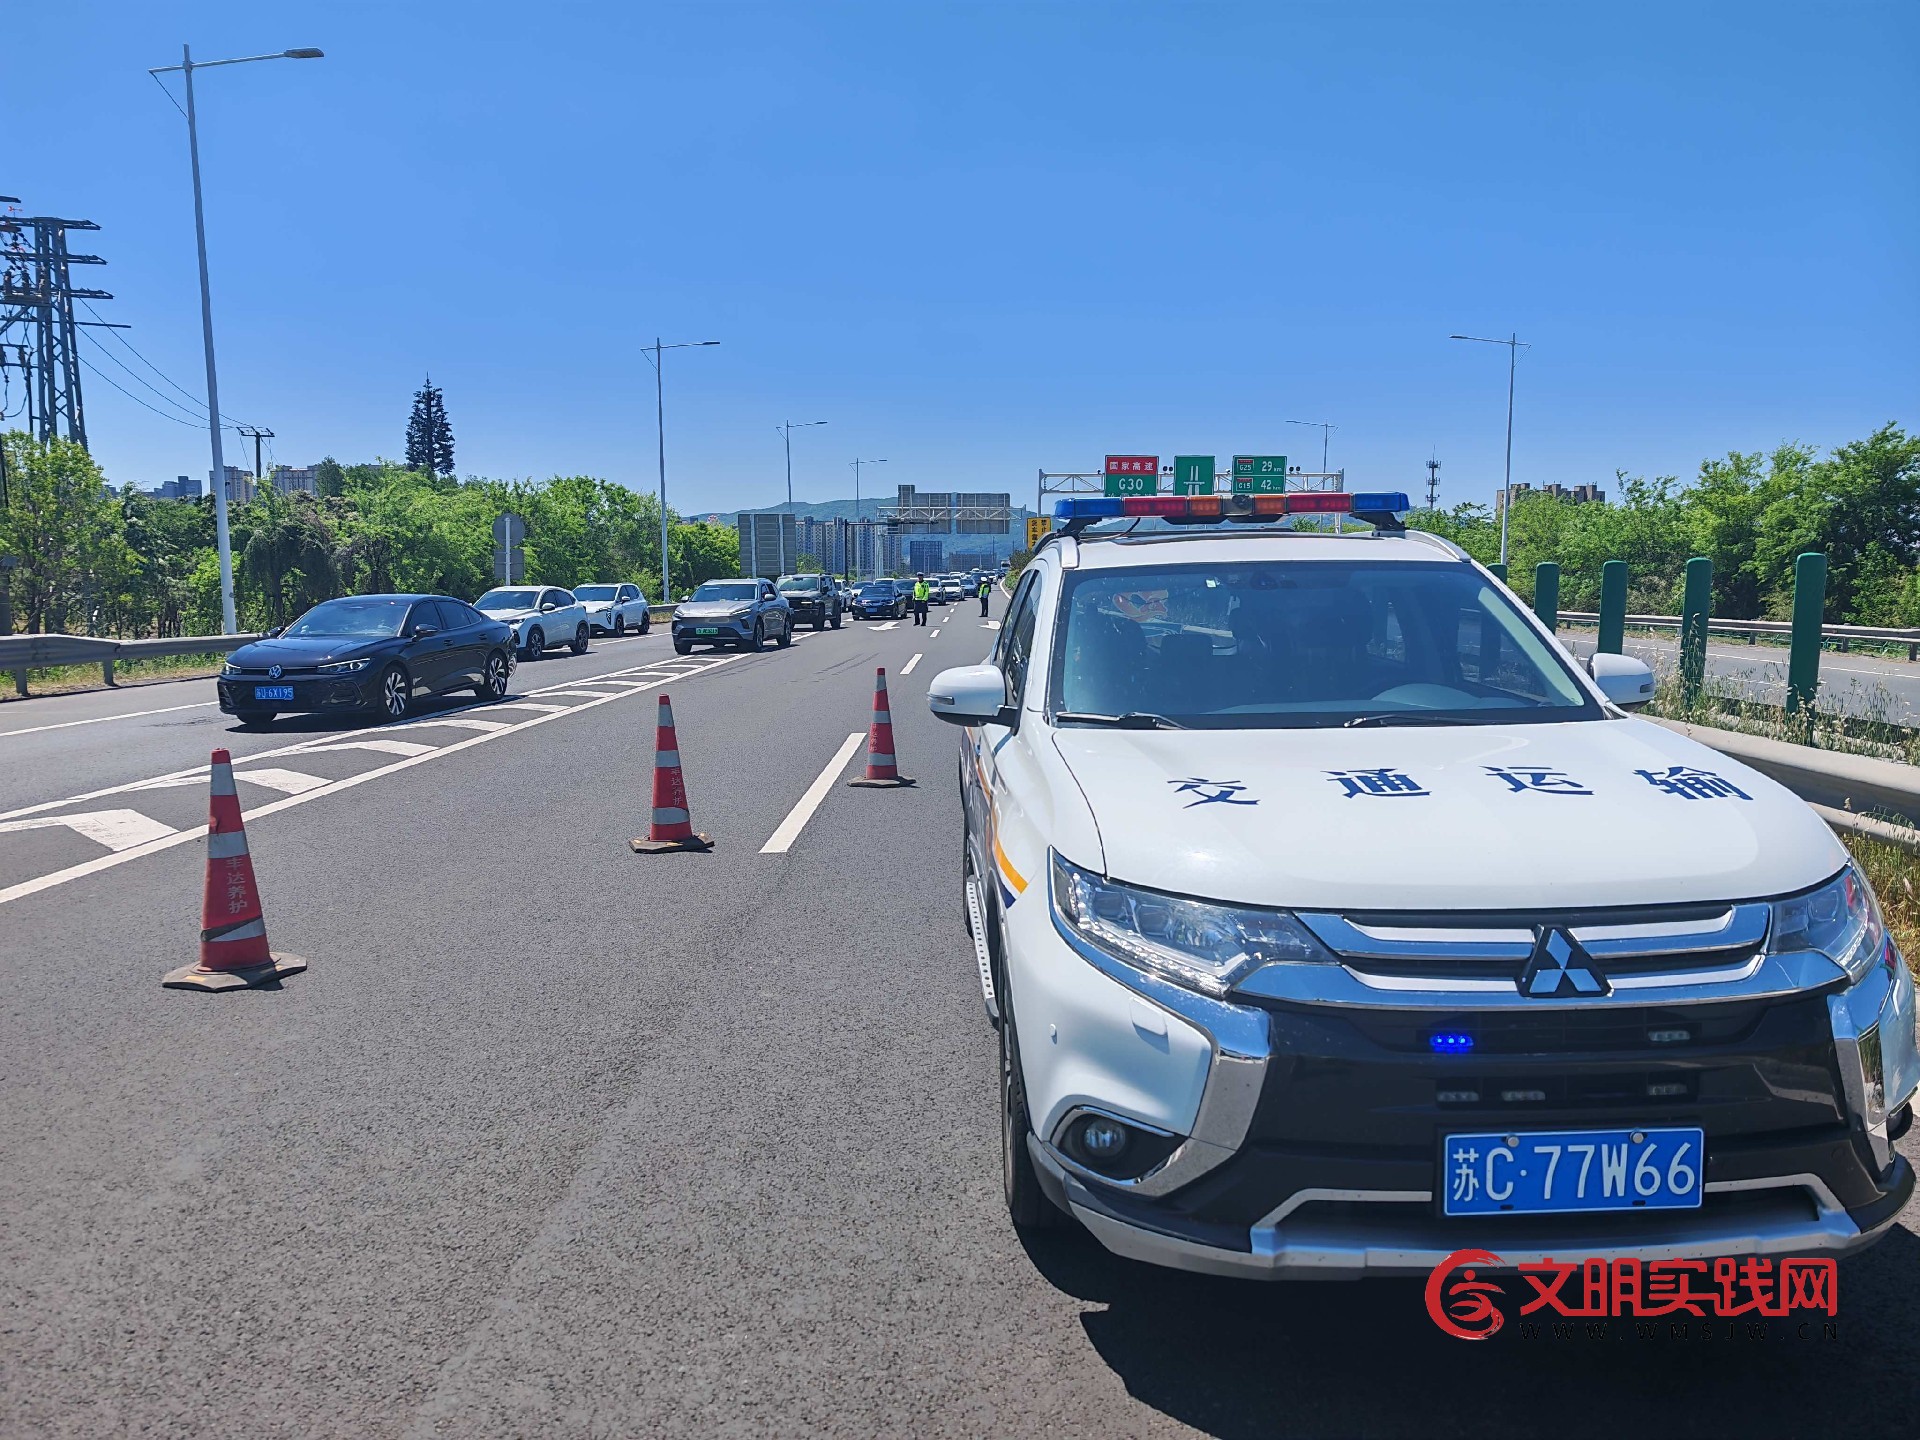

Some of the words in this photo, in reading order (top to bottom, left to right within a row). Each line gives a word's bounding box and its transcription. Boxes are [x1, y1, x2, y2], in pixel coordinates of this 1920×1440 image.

[1109, 461, 1154, 471] 国家高速
[1261, 460, 1273, 472] 29
[1118, 477, 1144, 491] G30
[1260, 479, 1272, 490] 42
[1167, 765, 1755, 810] 交通运输
[1453, 1142, 1695, 1202] 苏C·77W66
